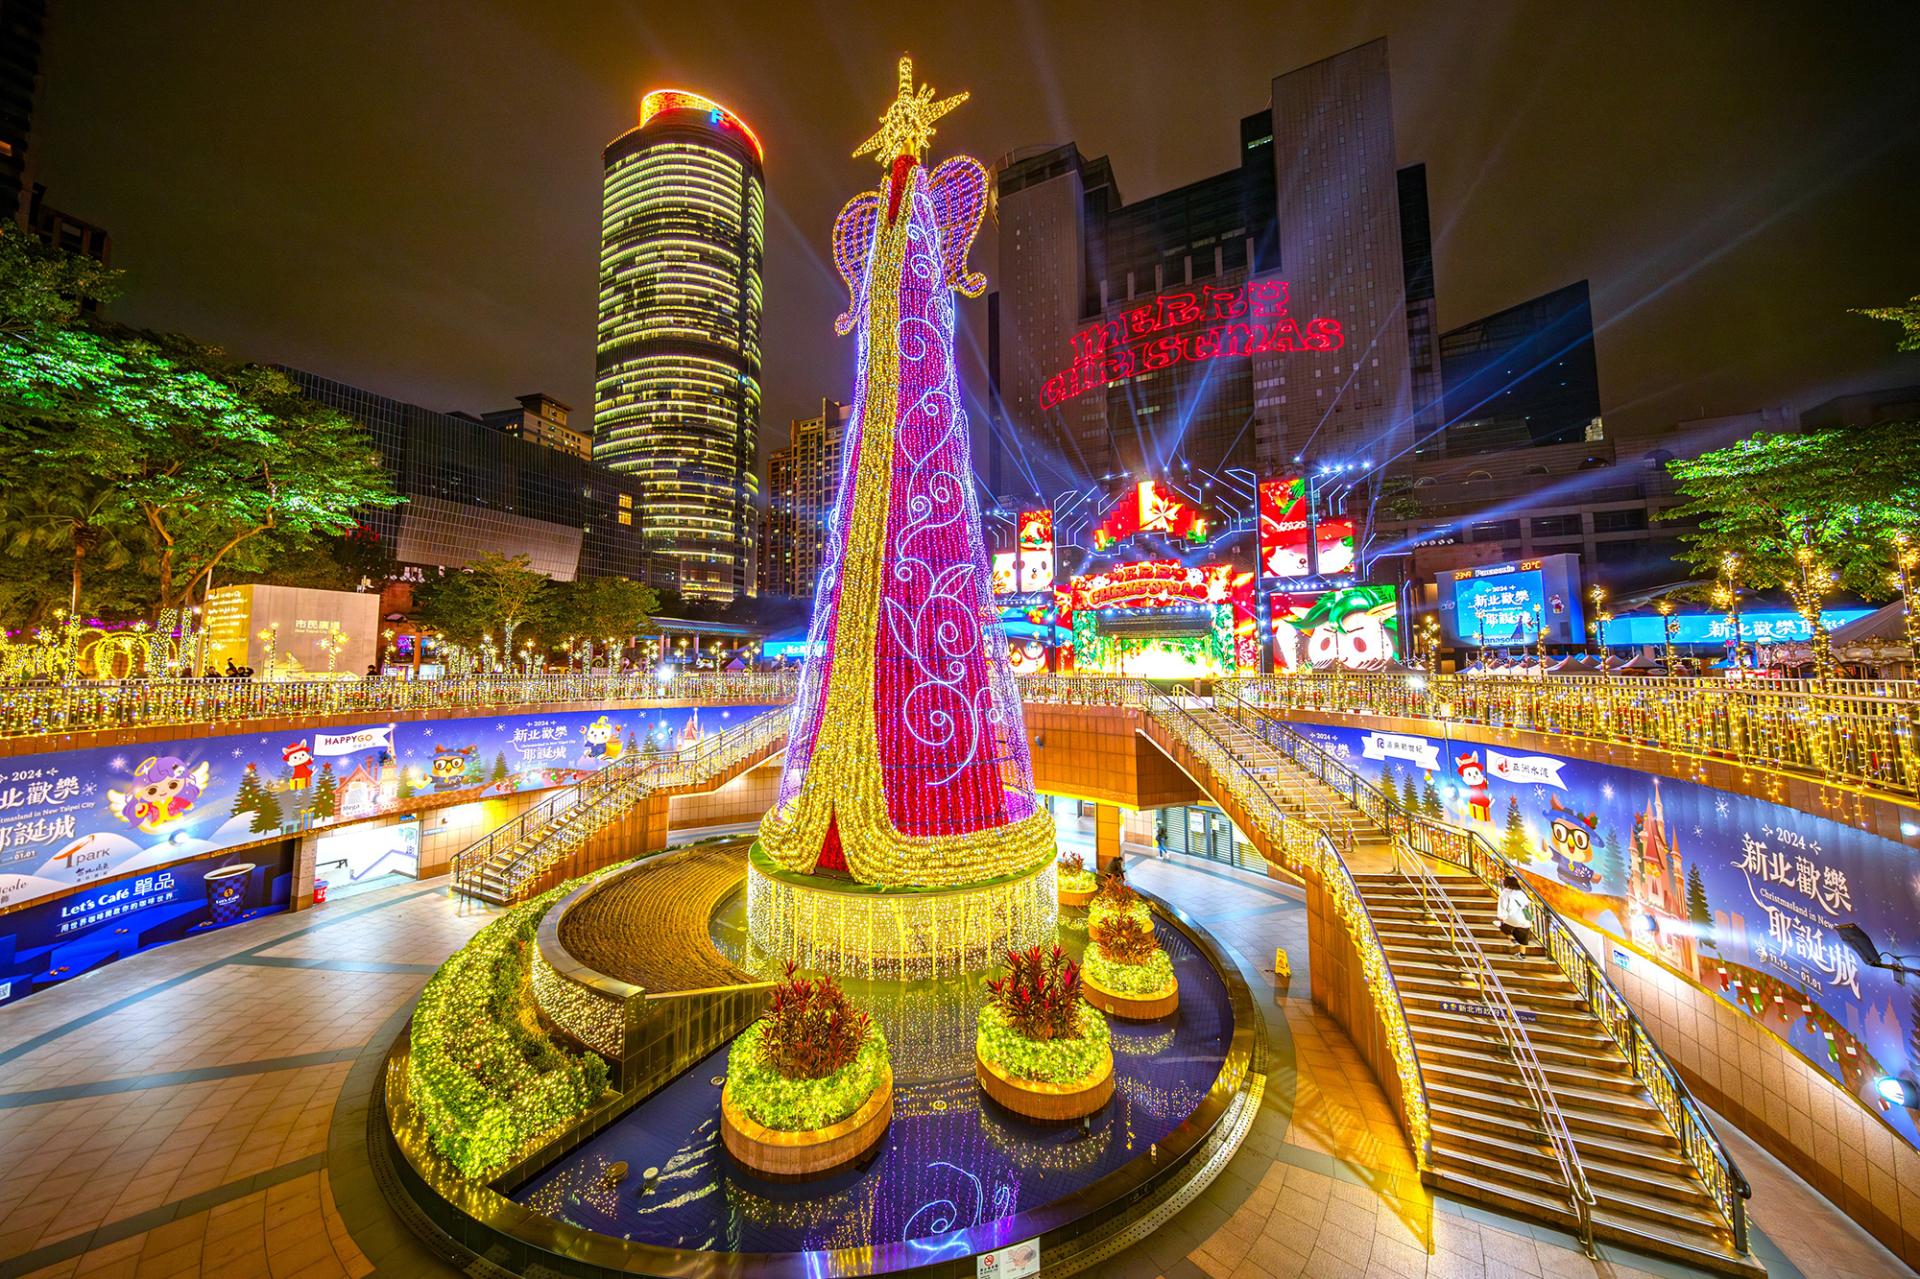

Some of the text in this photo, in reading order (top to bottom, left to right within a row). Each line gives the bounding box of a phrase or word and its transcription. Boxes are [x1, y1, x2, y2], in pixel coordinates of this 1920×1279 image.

[1070, 280, 1290, 358] MERRY
[1039, 317, 1345, 410] CHRISTMAS
[1089, 580, 1209, 607] CHRISTMAS
[324, 734, 373, 746] HAPPYGO
[512, 725, 568, 742] 新北歡樂
[12, 768, 43, 781] 2024
[1776, 827, 1807, 850] 2024
[133, 872, 175, 896] 單品
[1734, 832, 1853, 917] 新北歡樂
[61, 889, 130, 918] Let's Café
[1759, 887, 1808, 916] Christmasland
[1808, 911, 1816, 921] in
[1767, 905, 1862, 1000] 耶誕城
[1800, 970, 1822, 991] 01.01
